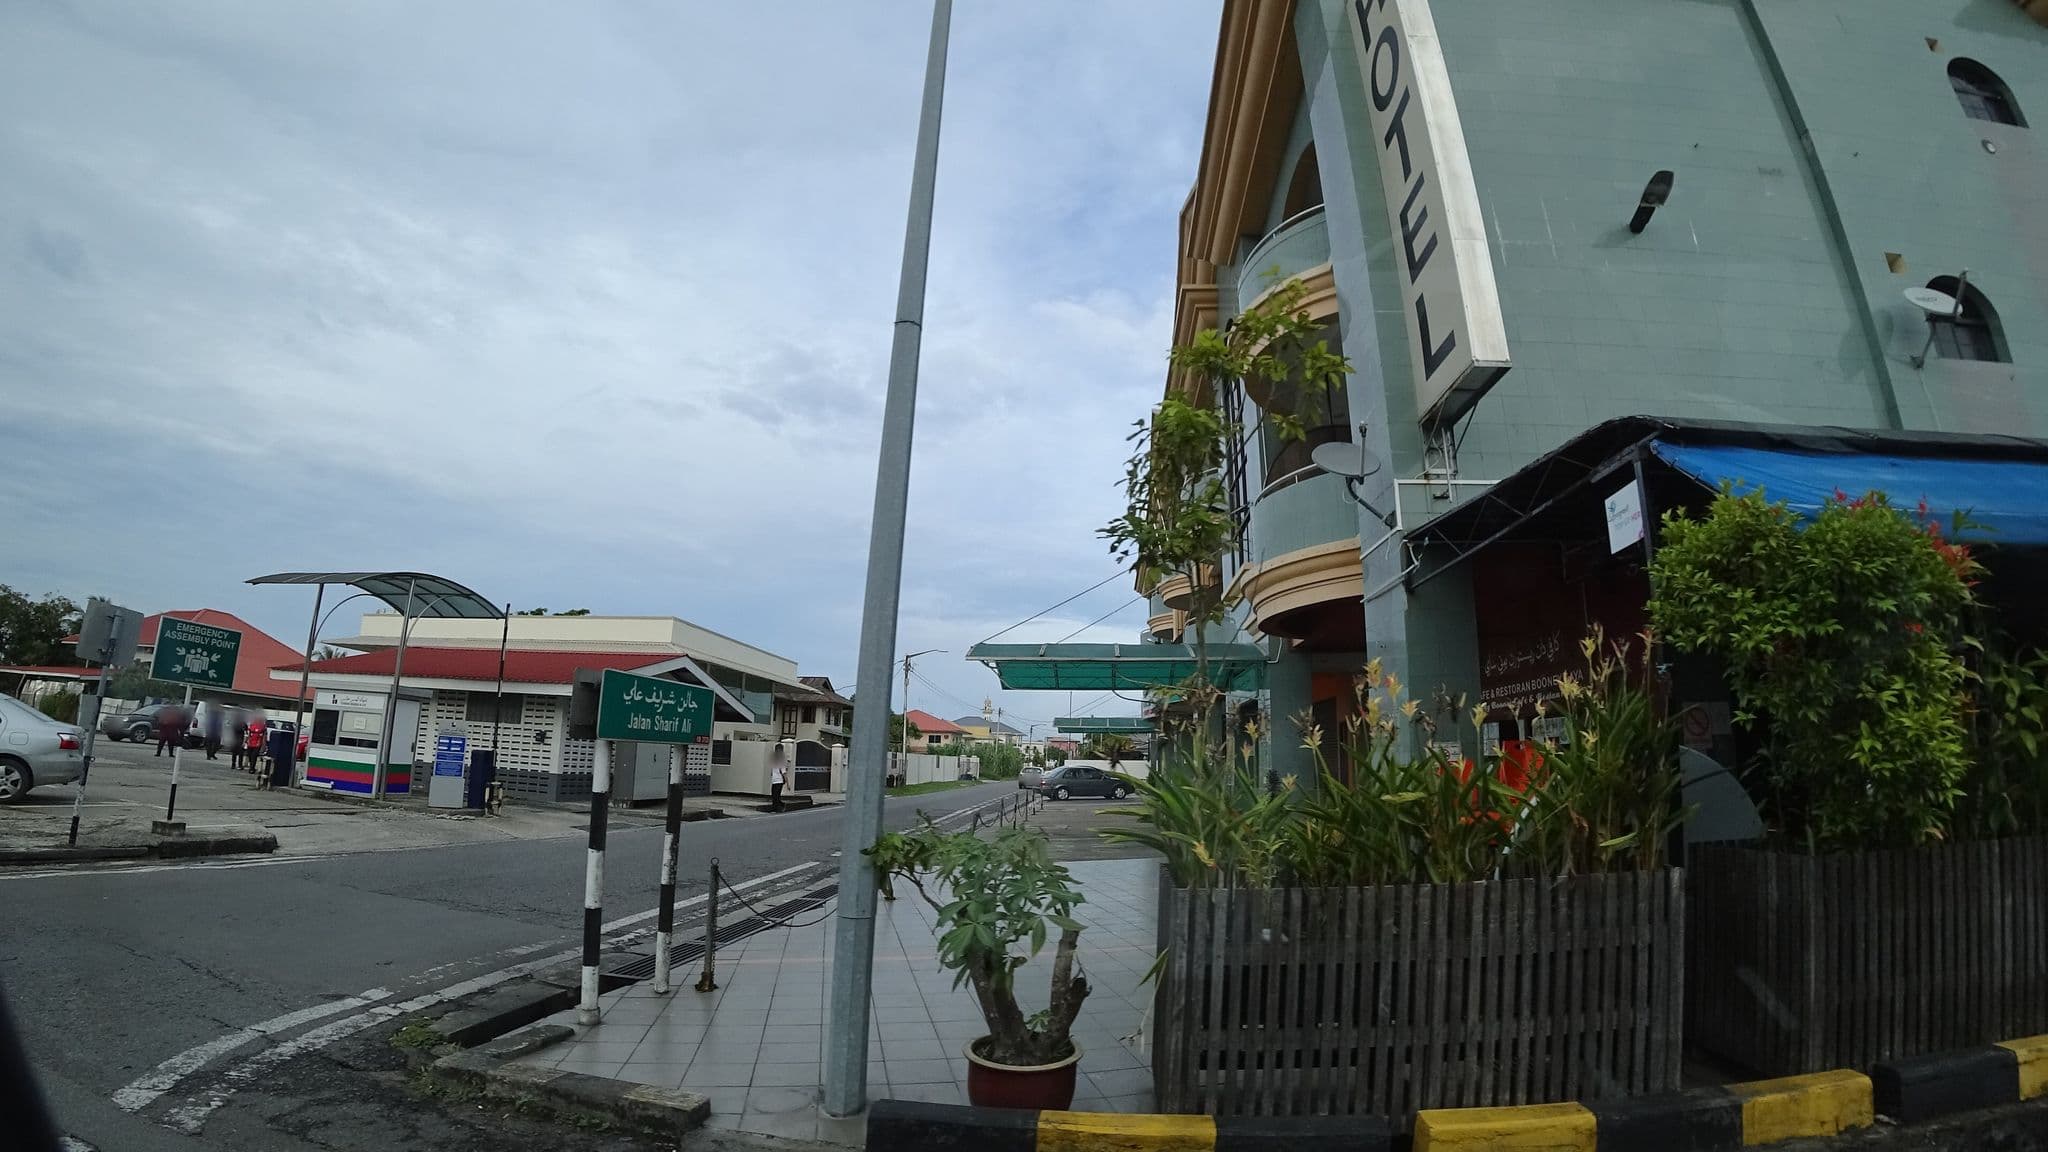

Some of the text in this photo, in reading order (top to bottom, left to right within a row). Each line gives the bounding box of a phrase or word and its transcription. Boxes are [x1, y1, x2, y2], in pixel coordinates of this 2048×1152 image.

[164, 630, 236, 649] ASSEMBLY POINT
[176, 622, 230, 640] EMERGENCY
[623, 679, 698, 713] جالن شريف علي
[1495, 680, 1531, 698] RESTORAN
[627, 712, 692, 733] Jalan Sharif Ali
